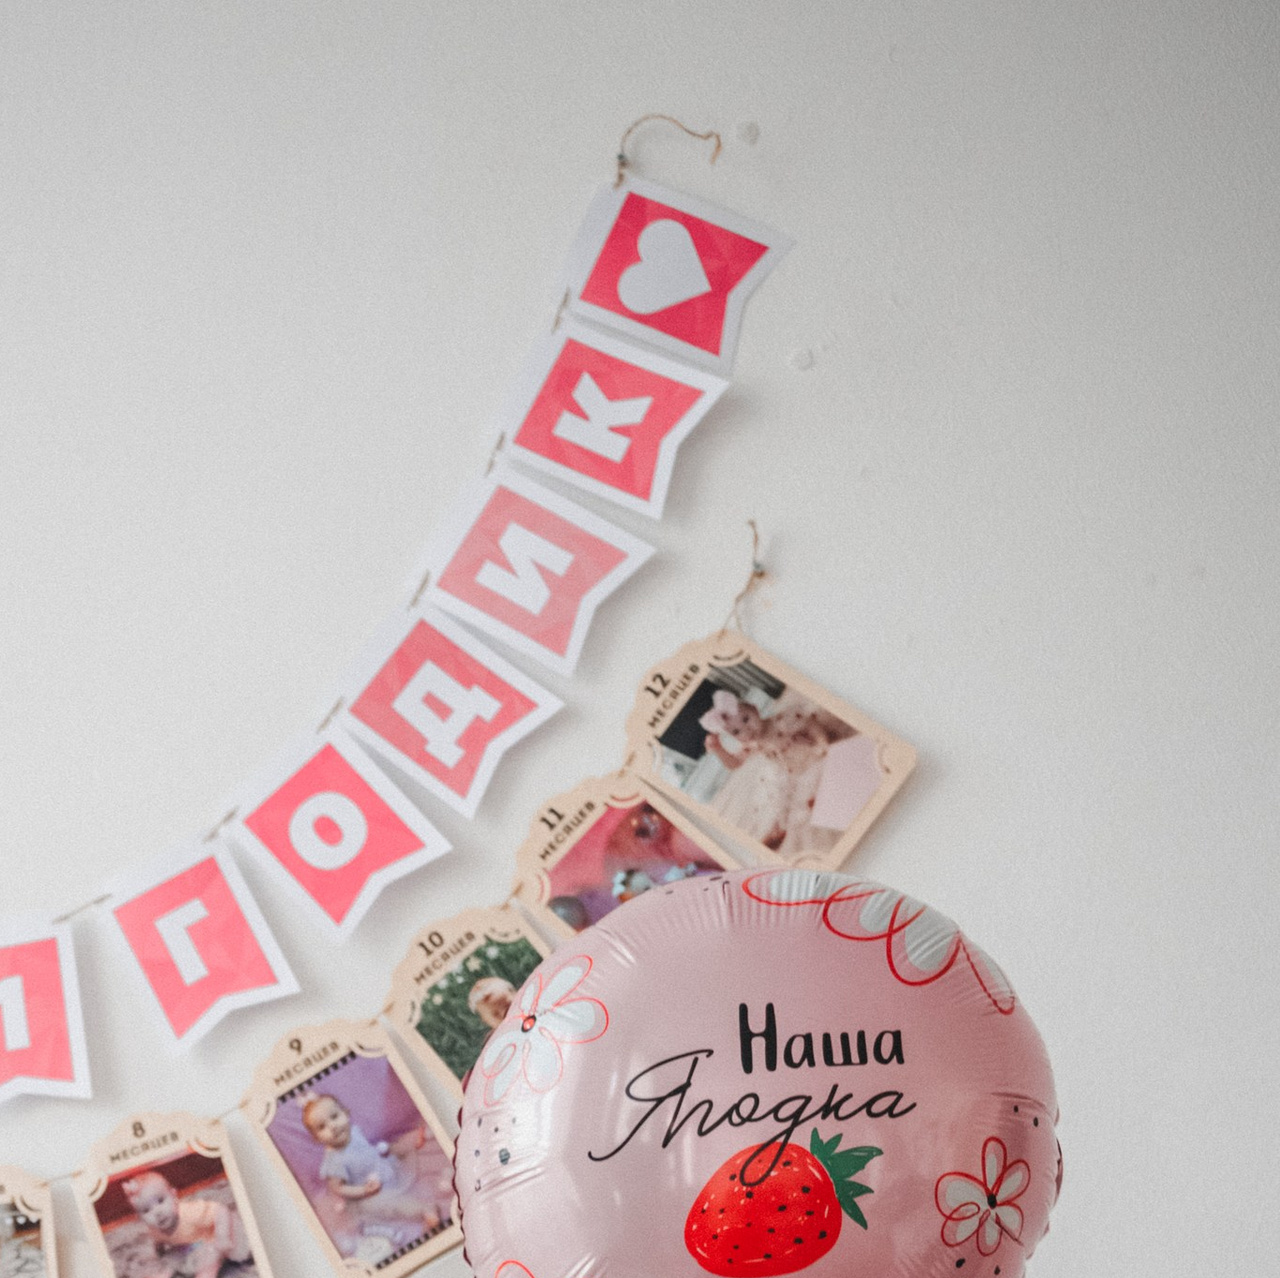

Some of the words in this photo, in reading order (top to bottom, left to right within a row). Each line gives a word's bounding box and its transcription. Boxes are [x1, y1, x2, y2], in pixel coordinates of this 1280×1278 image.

[643, 673, 671, 697] 12
[648, 663, 700, 729] МЕСЯЦЕВ
[539, 801, 596, 860] МЕСЯЦЕВ
[540, 807, 564, 831] 11
[414, 931, 475, 985] МЕСЯЦЕВ
[418, 931, 444, 956] 10
[289, 1038, 302, 1055] 9
[738, 1003, 904, 1074] Наша
[274, 1041, 339, 1086] МЕСЯЦЕВ
[132, 1121, 146, 1138] 8
[589, 1049, 916, 1187] Ягодка
[110, 1131, 179, 1163] МЕСЯЦЕВ
